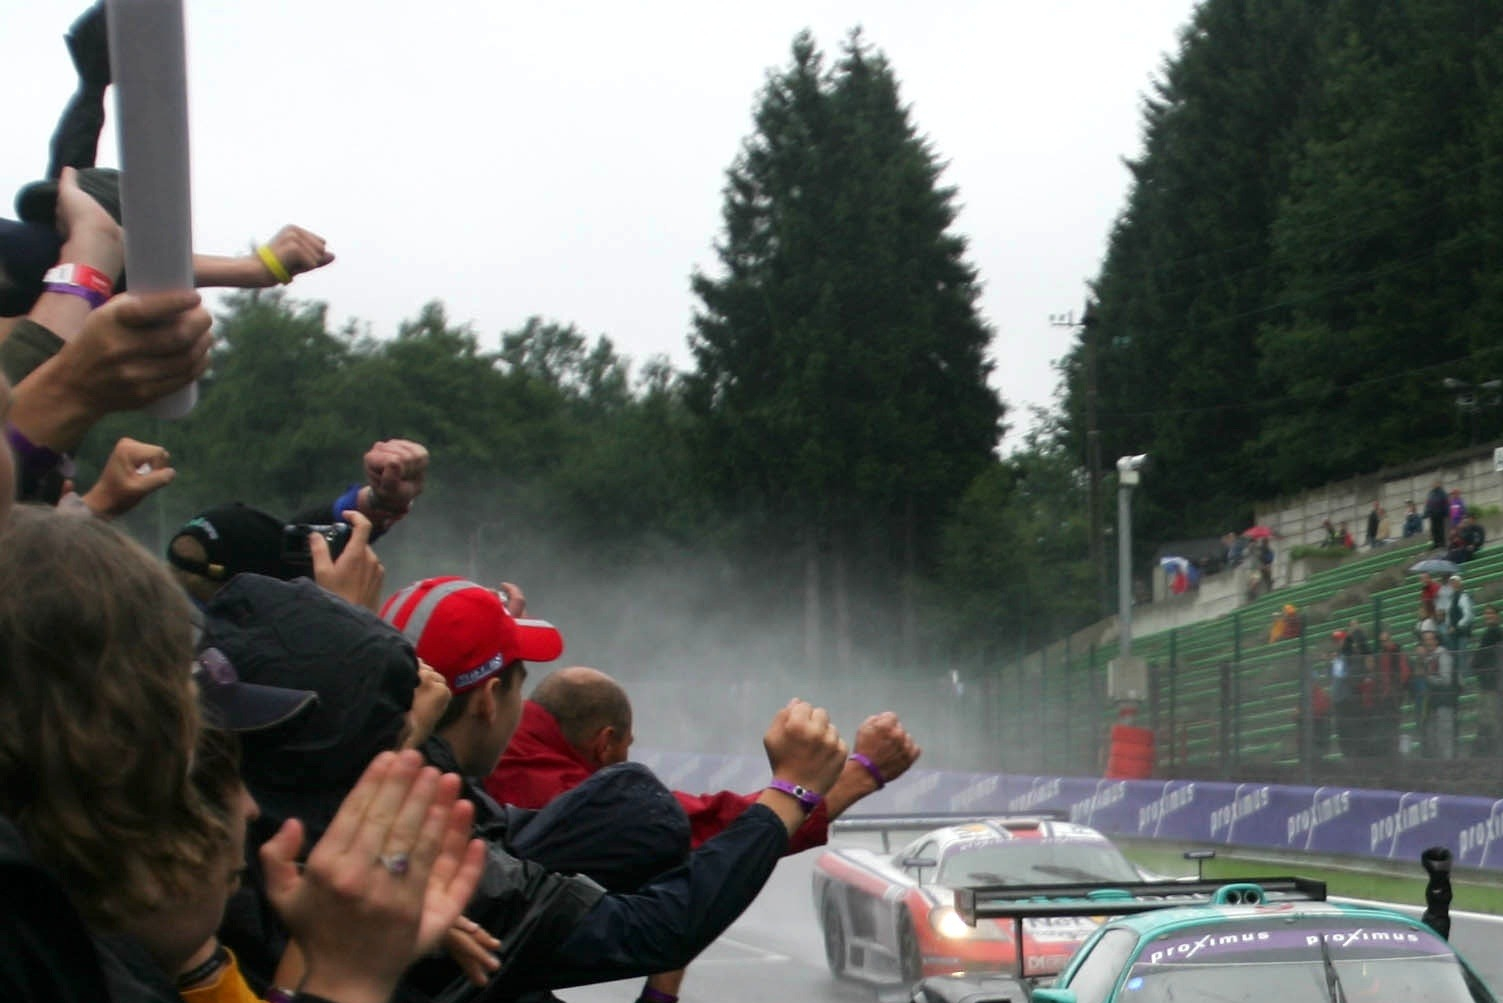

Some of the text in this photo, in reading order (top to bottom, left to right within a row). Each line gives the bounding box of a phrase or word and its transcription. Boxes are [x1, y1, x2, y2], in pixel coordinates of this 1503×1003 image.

[1209, 783, 1270, 844] proximus
[1287, 787, 1351, 850] proximus
[1370, 791, 1440, 859] proximus
[1150, 930, 1272, 964] proximus
[1306, 928, 1420, 948] proximus
